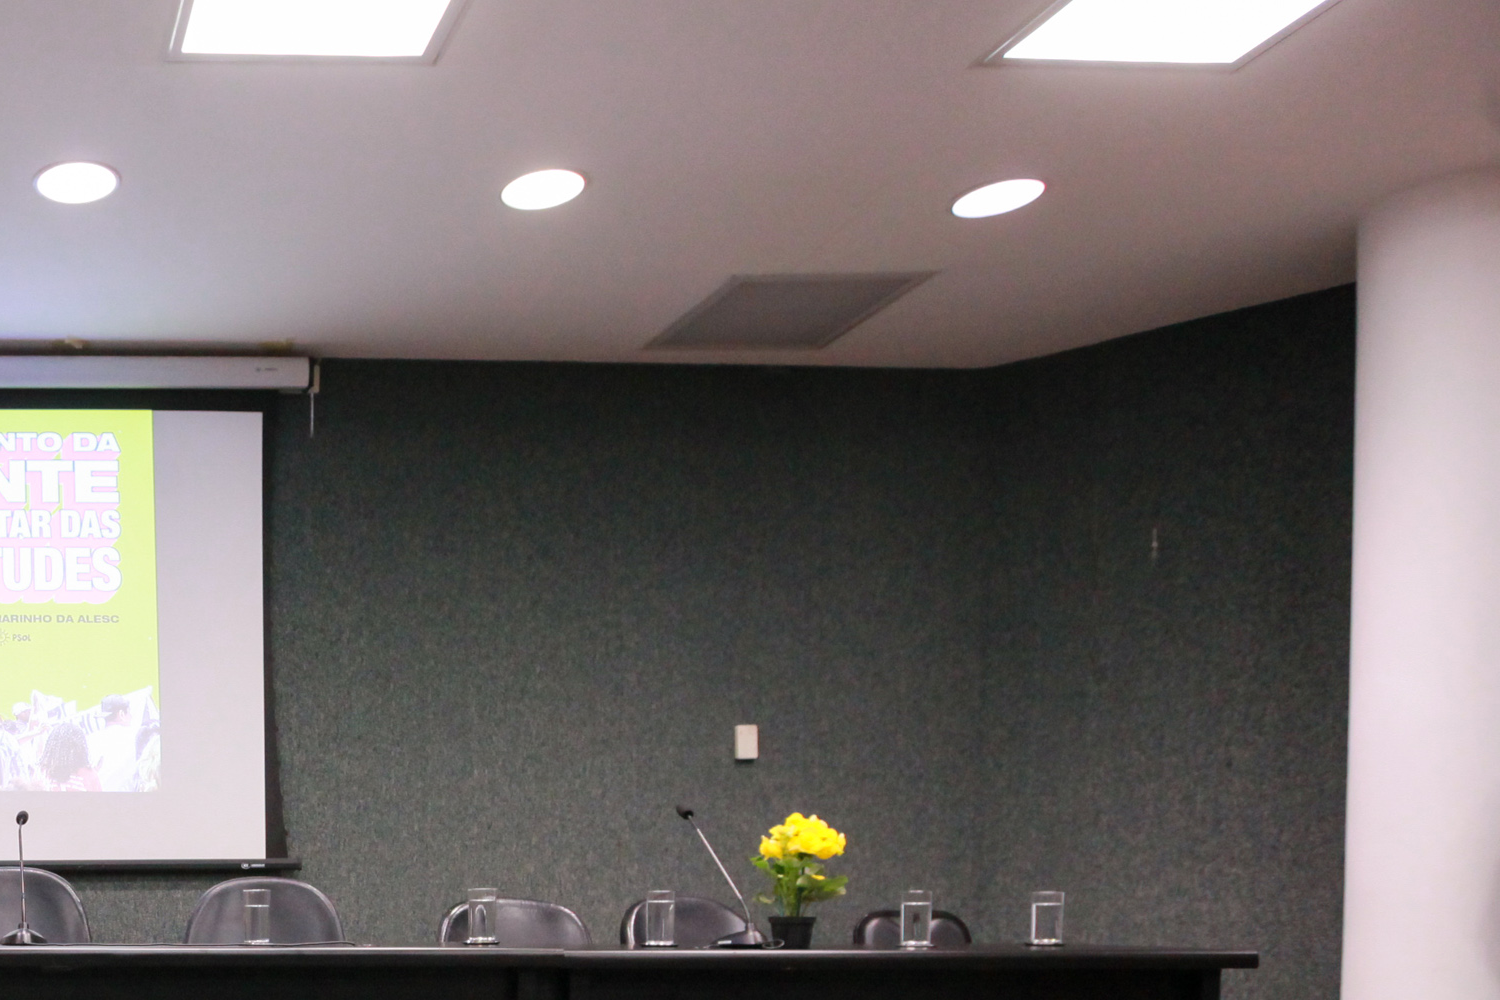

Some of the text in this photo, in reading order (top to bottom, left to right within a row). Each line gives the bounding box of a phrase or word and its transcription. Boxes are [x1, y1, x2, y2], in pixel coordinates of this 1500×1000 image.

[72, 431, 122, 453] DA
[59, 507, 122, 539] DAS
[56, 614, 74, 624] DA
[77, 614, 120, 624] ALESC
